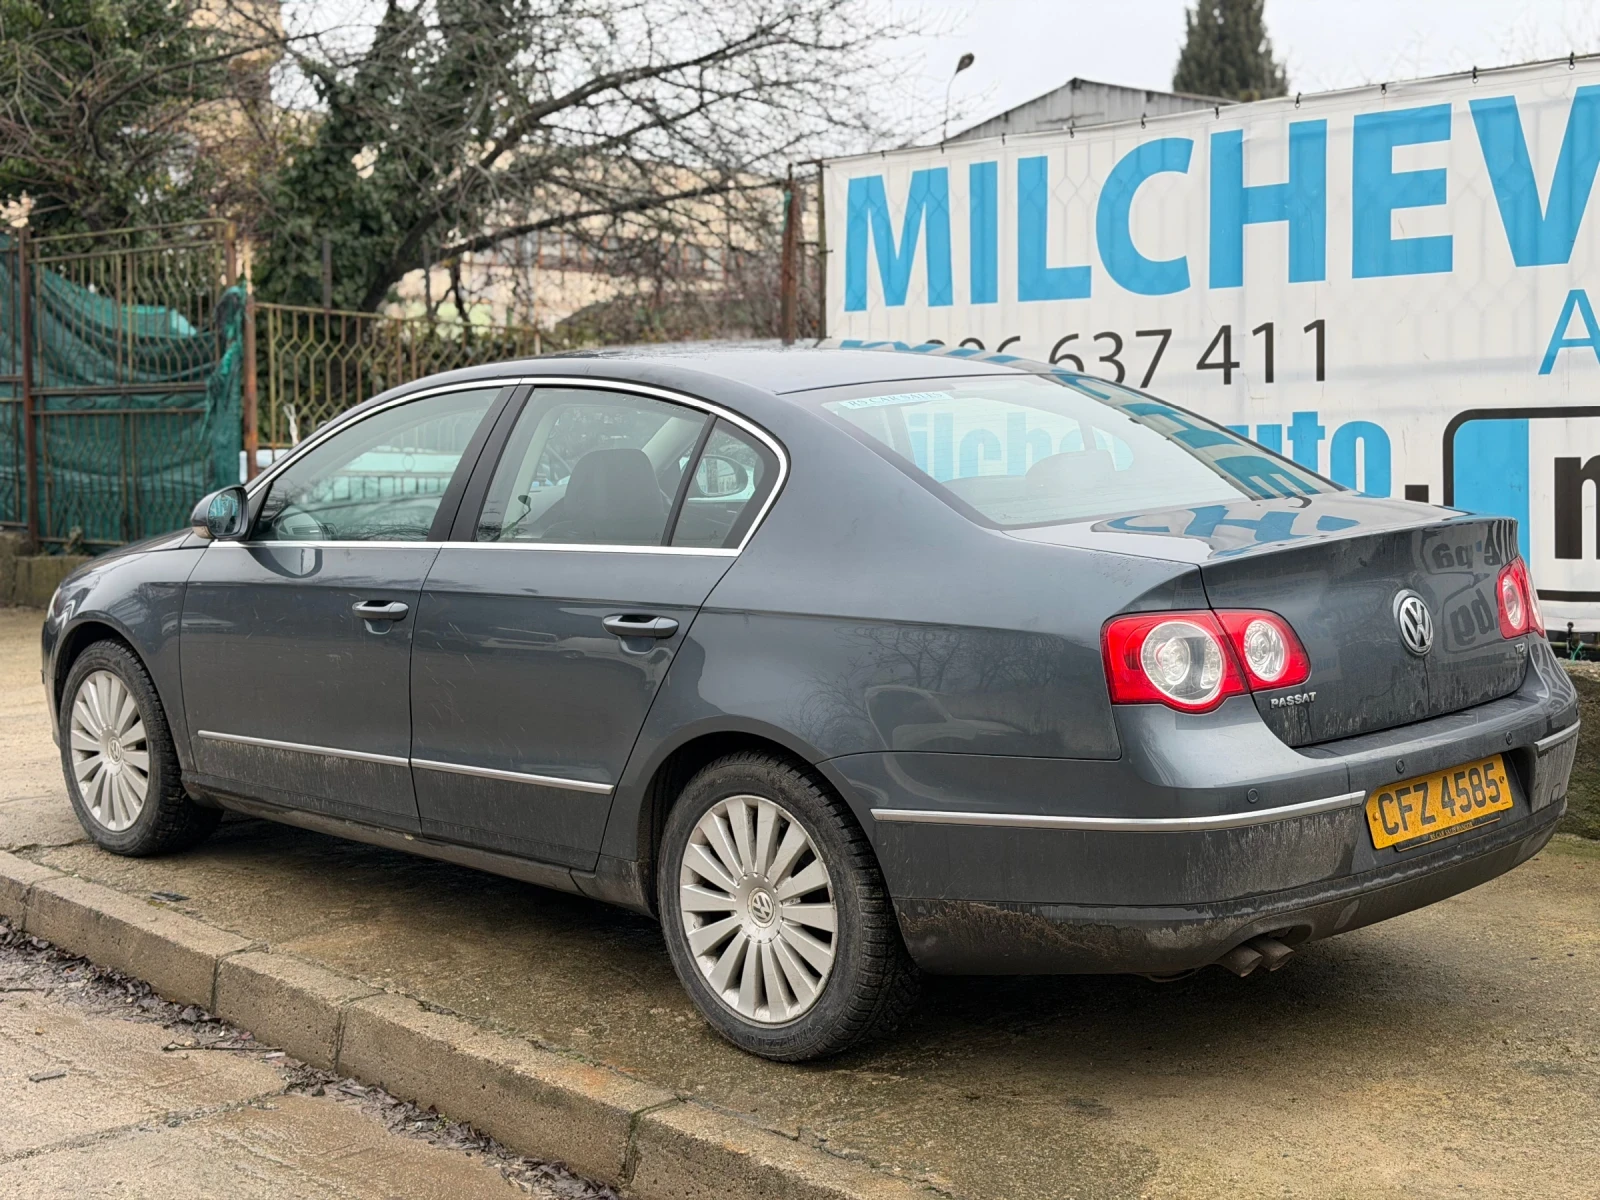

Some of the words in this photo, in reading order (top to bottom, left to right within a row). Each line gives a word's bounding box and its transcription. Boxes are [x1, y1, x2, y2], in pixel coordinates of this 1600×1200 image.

[843, 84, 1600, 313] MILCHEV
[1196, 319, 1325, 385] 411
[1270, 691, 1316, 709] PASSAT
[1377, 781, 1436, 836] CFZ
[1441, 762, 1501, 817] 4585
